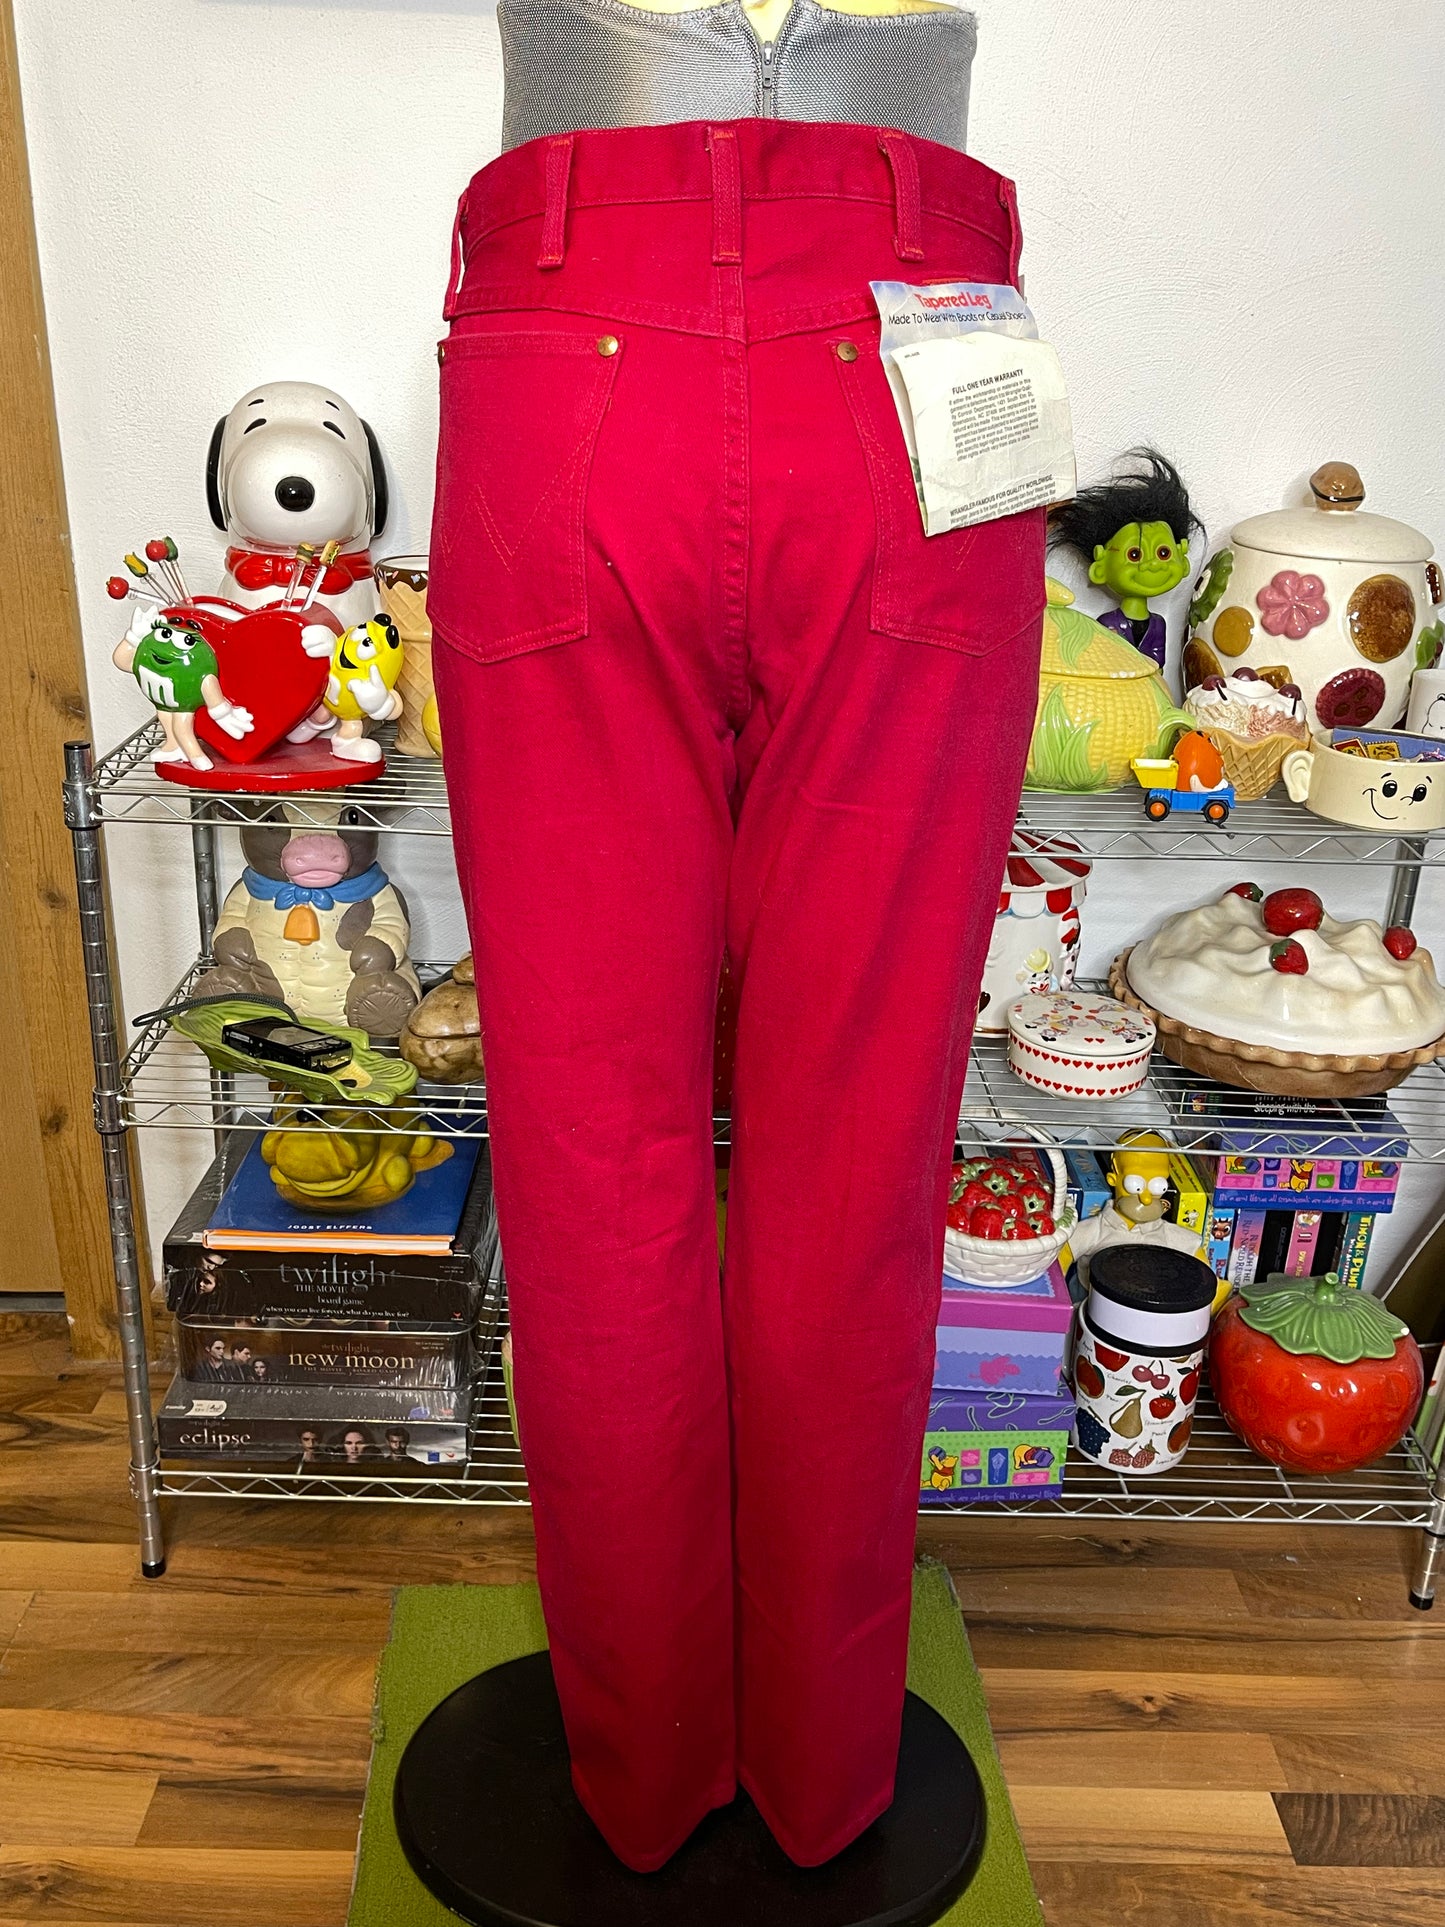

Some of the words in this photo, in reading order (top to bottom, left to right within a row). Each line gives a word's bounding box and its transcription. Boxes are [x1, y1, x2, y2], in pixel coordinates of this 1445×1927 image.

[914, 293, 967, 310] Tapered
[967, 292, 992, 310] Leg
[889, 314, 911, 325] Made
[912, 314, 922, 324] To
[922, 312, 940, 322] Wear
[940, 312, 956, 322] With
[956, 311, 977, 322] Boots
[978, 312, 986, 320] or
[986, 312, 1006, 320] Casual
[952, 385, 966, 395] FULL
[967, 381, 979, 390] ONE
[979, 377, 993, 386] YEAR
[994, 368, 1023, 382] WARRANTY
[996, 492, 1006, 500] FOR
[1006, 484, 1025, 496] QUALITY
[1026, 474, 1052, 488] WORLDWIDE
[1254, 1102, 1285, 1115] sleeping
[1286, 1102, 1302, 1113] with
[1304, 1102, 1316, 1113] the
[1357, 1216, 1372, 1250] TIMON
[1356, 1250, 1364, 1258] &
[280, 1254, 397, 1292] twilight
[1242, 1266, 1250, 1283] THE
[316, 1285, 348, 1294] MOVIE
[318, 1295, 341, 1305] board
[343, 1298, 364, 1306] game
[289, 1353, 338, 1366] new
[345, 1355, 414, 1368] moon
[180, 1428, 250, 1452] eclipse
